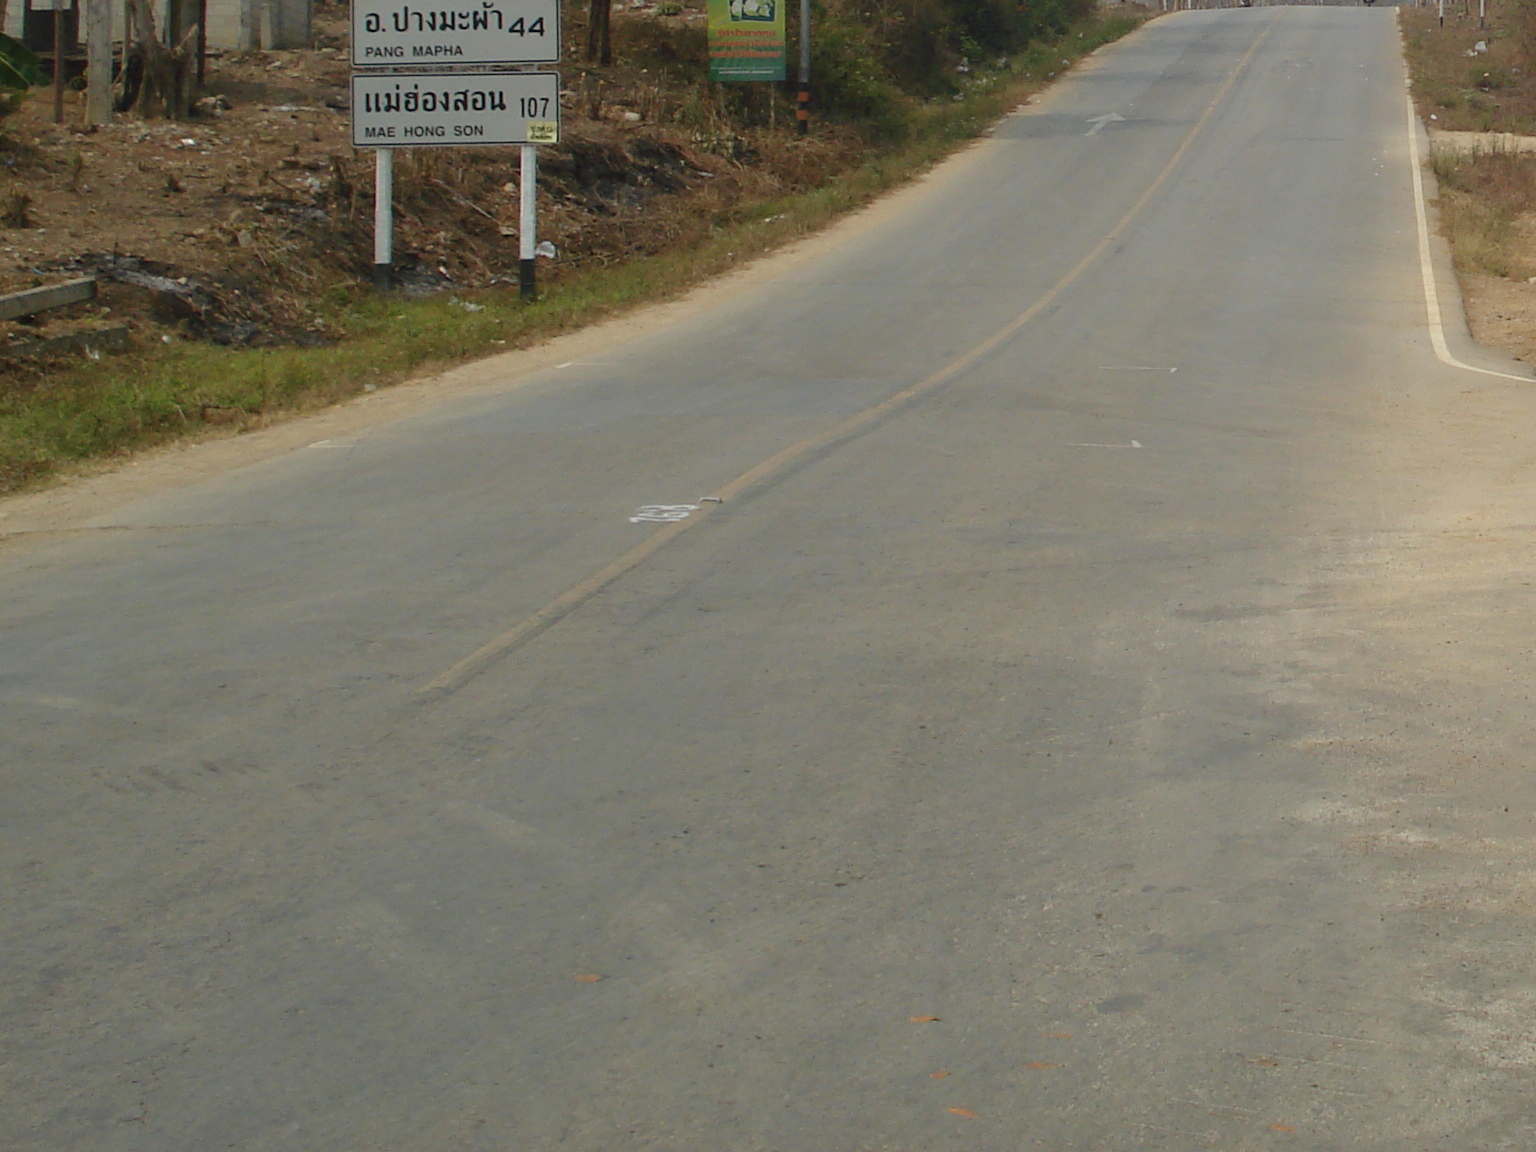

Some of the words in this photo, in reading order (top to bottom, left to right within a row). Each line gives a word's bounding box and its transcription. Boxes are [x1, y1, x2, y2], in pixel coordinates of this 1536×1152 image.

[392, 1, 504, 33] ปางมะผ้า
[507, 16, 546, 38] 44
[364, 45, 404, 58] PANG
[412, 45, 464, 57] MAPHA
[365, 83, 508, 114] แม่ฮ่องสอน
[520, 97, 549, 119] 107
[364, 126, 397, 139] MAE
[403, 126, 446, 138] HONG
[453, 125, 485, 137] SON
